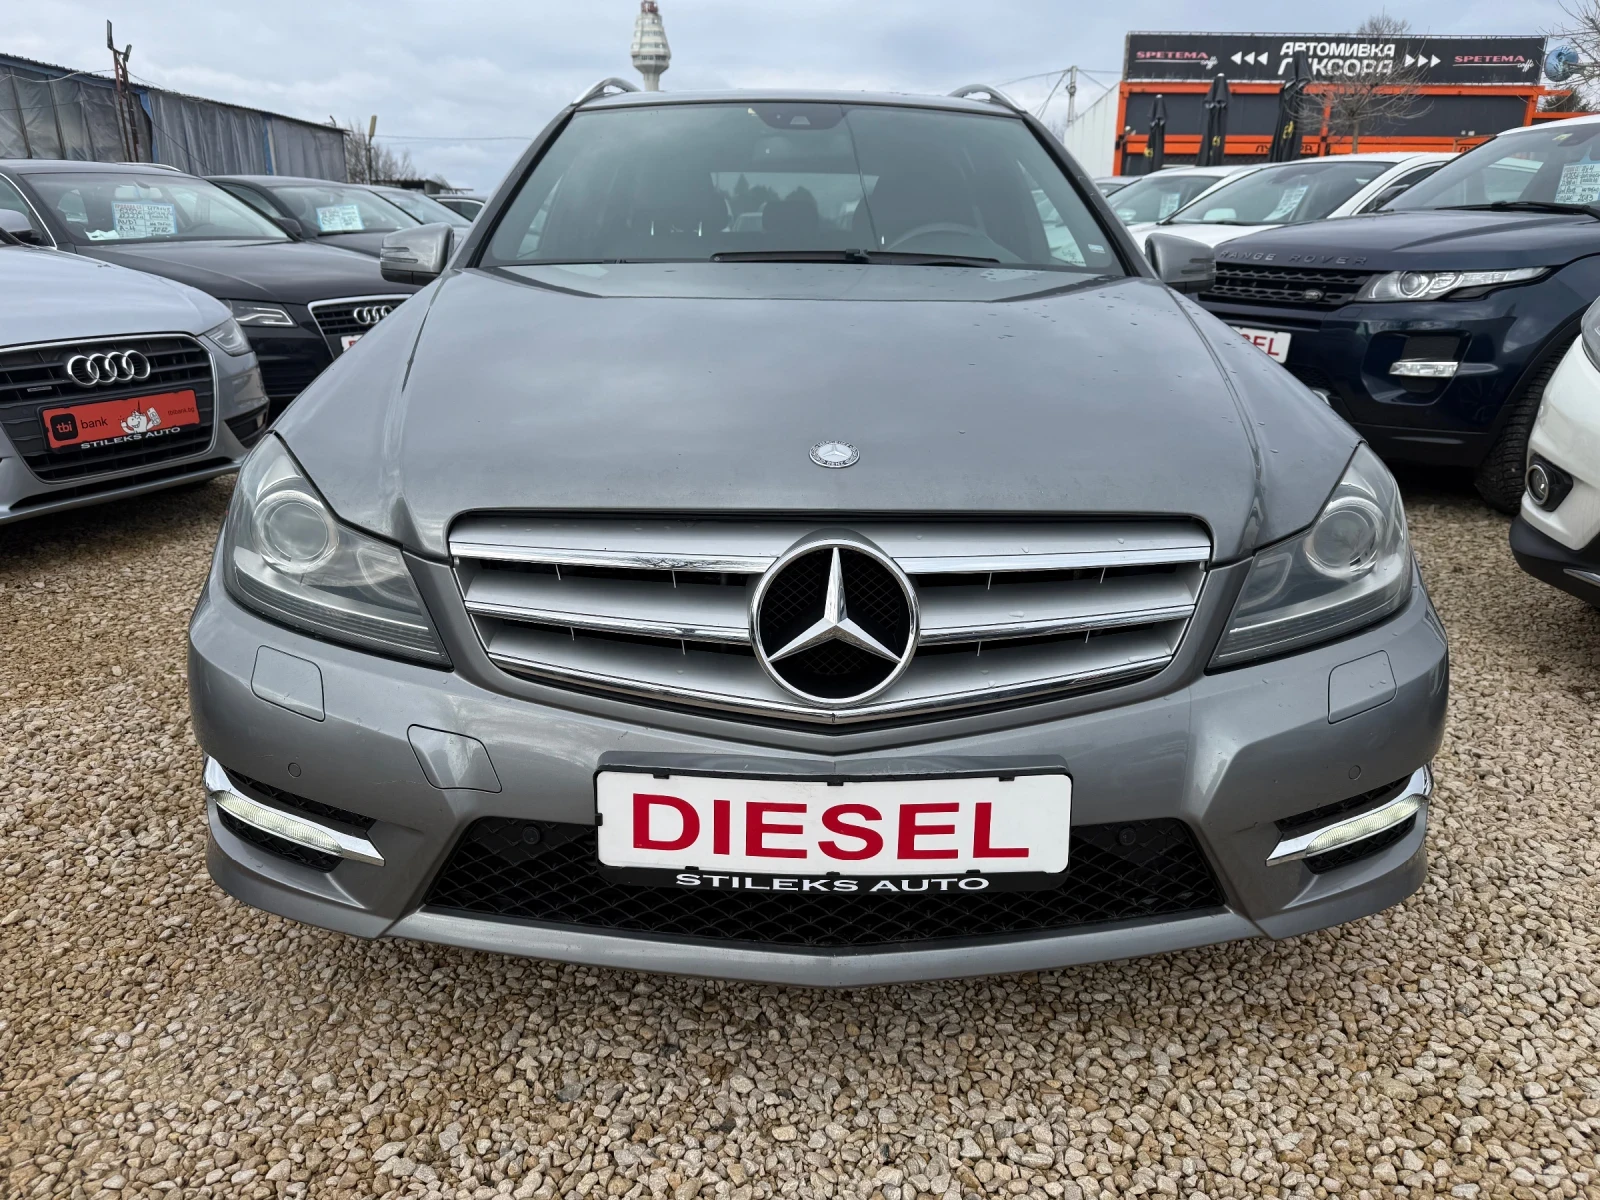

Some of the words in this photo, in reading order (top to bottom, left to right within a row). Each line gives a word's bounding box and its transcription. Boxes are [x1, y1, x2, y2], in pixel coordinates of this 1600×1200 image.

[1136, 51, 1209, 59] SPETEMA
[1455, 55, 1525, 63] SPETEMA
[1218, 250, 1277, 262] RANGE
[1288, 254, 1369, 266] ROVER
[56, 423, 73, 433] tbi
[80, 417, 109, 430] bank
[80, 434, 143, 449] STILEKS
[145, 426, 181, 439] AUTO
[632, 793, 1030, 861] DIESEL
[675, 873, 860, 893] STILEKS
[869, 876, 990, 893] AUTO
